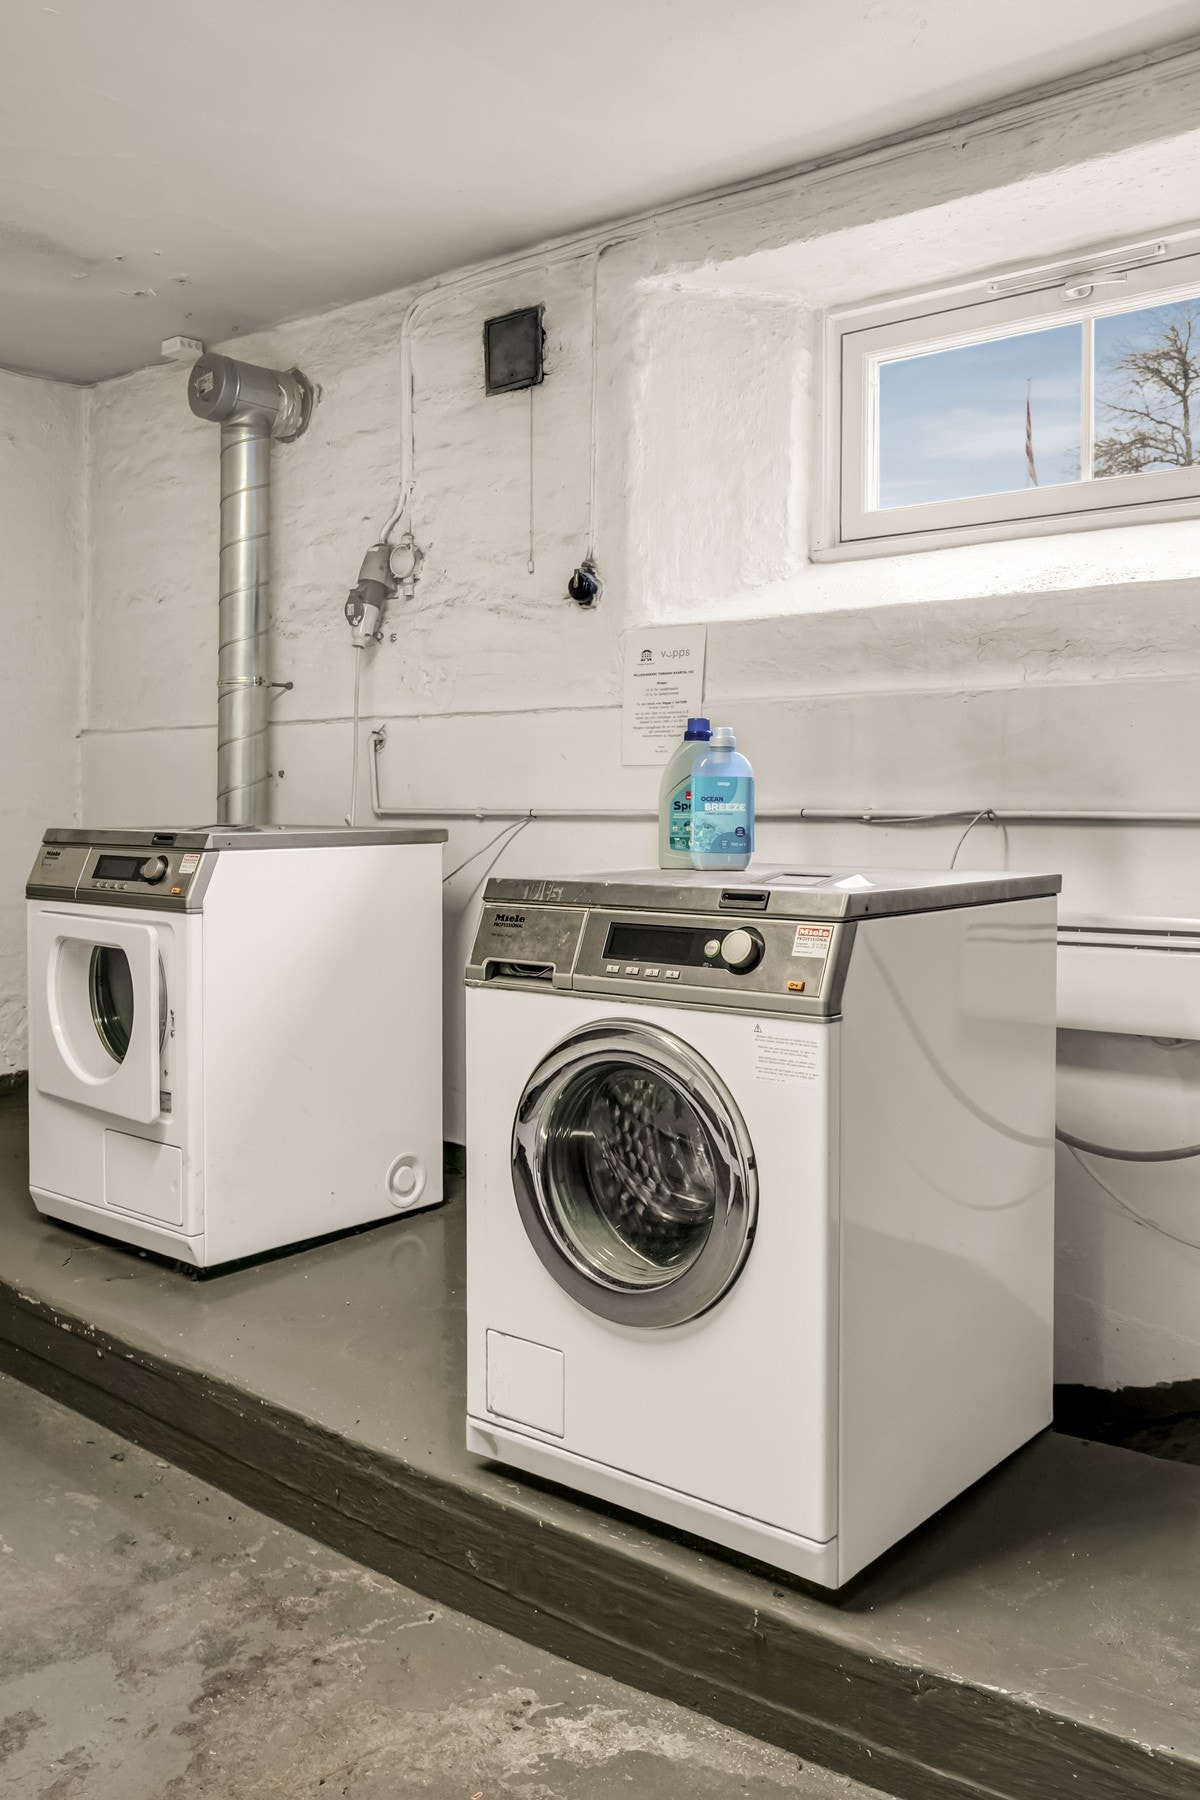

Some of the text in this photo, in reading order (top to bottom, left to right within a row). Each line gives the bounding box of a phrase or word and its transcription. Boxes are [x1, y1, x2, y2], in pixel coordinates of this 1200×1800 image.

[704, 803, 746, 812] BREEZE
[495, 913, 526, 922] Miele
[799, 928, 829, 936] Miele
